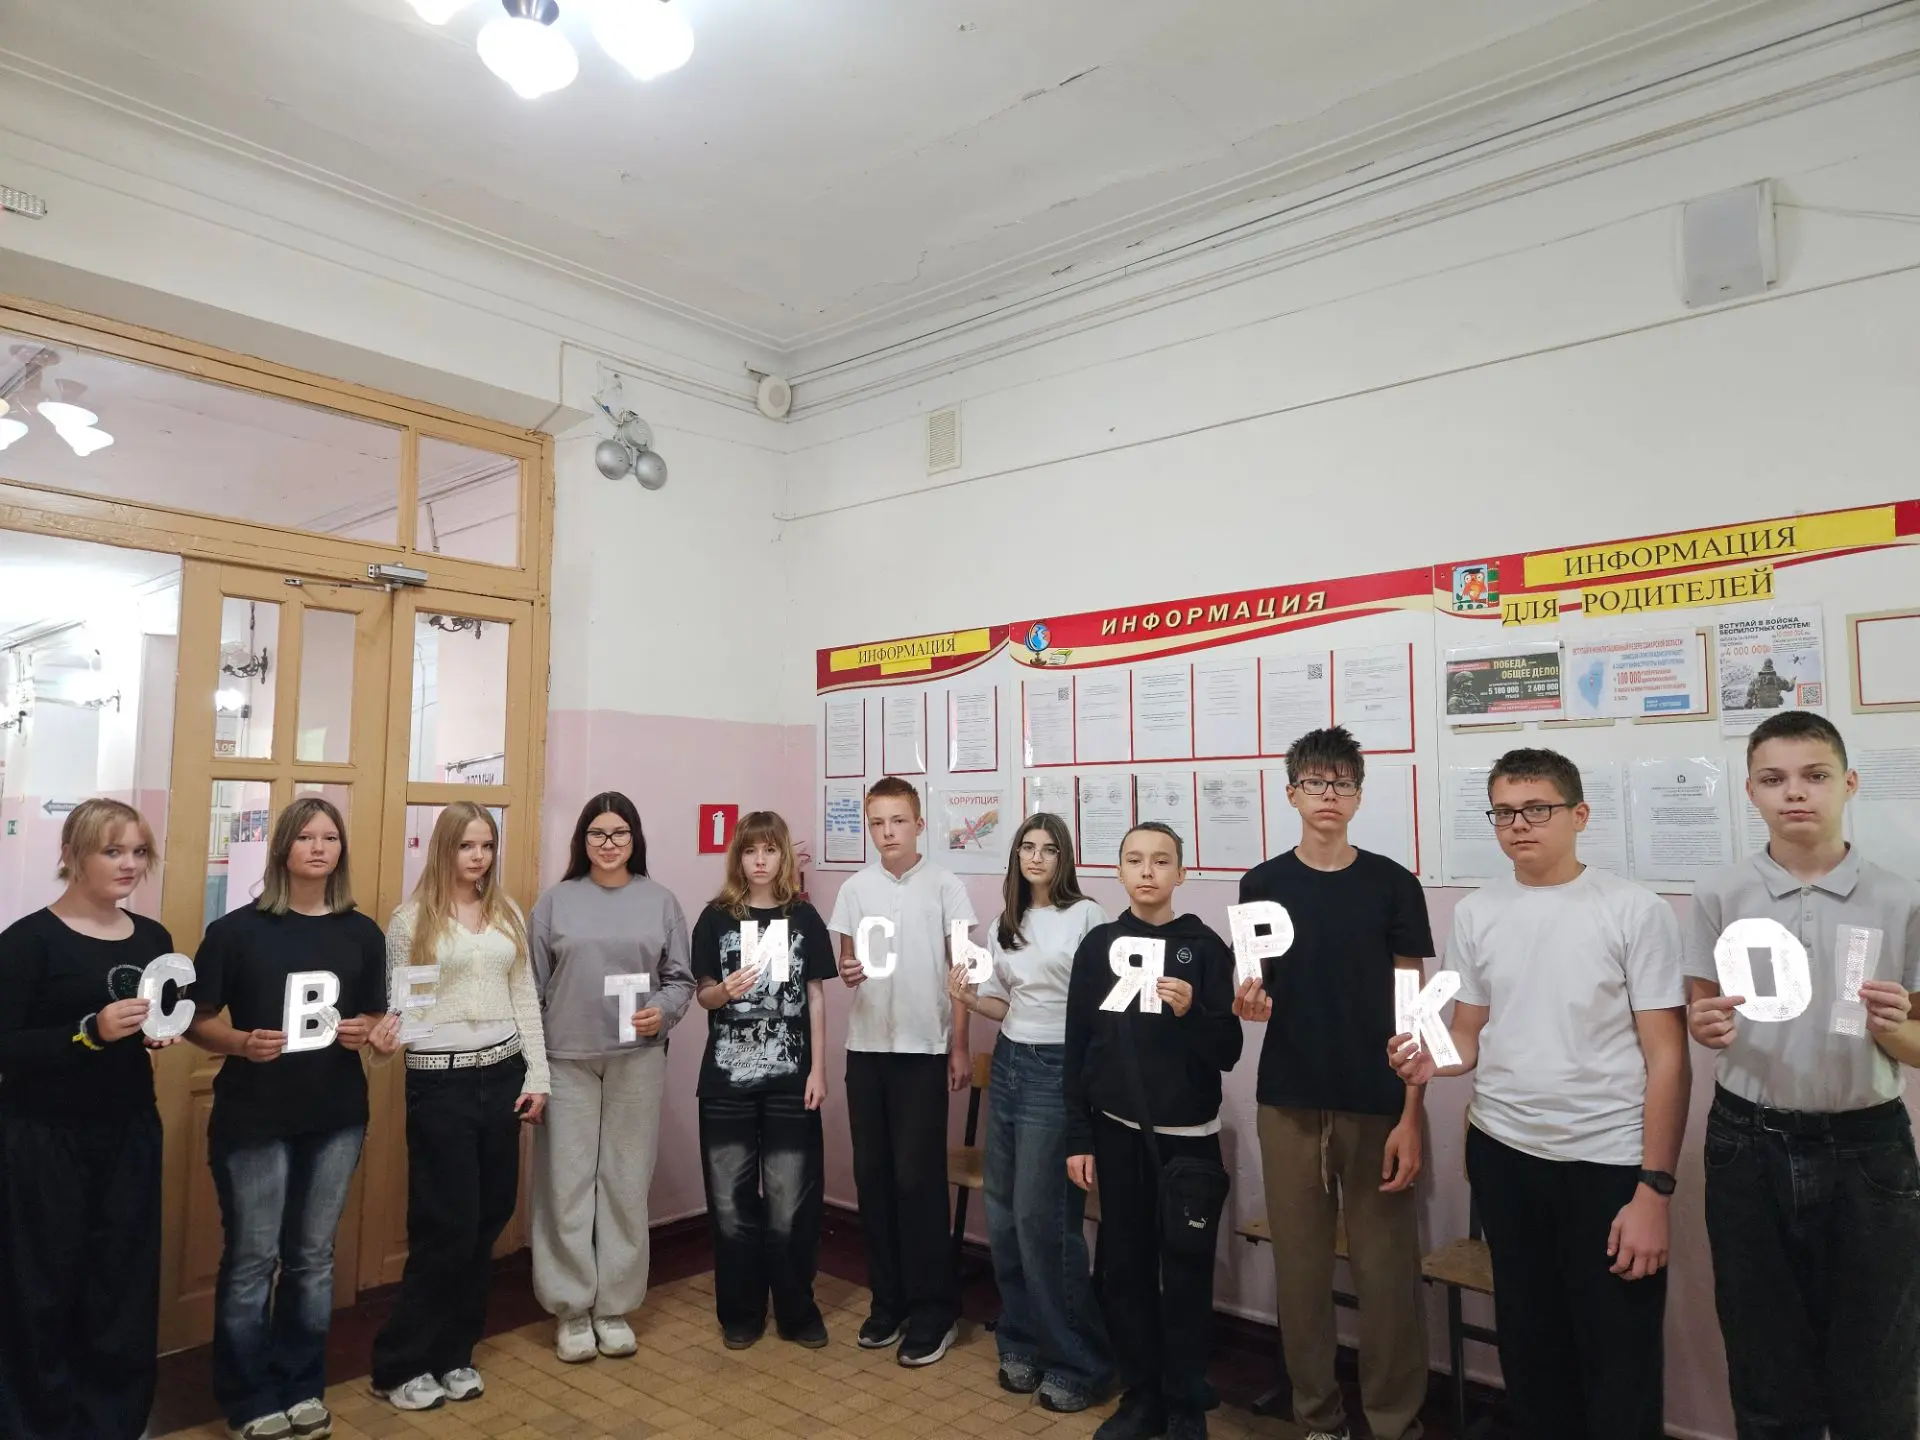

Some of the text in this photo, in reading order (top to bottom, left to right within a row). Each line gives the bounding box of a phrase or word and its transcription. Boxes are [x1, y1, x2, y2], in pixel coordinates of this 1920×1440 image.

[1563, 526, 1797, 577] ИНФОРМАЦИЯ
[1502, 566, 1774, 625] ДЛЯ РОДИТЕЛЕЙ
[1101, 591, 1327, 637] ИНФОРМАЦИЯ
[1719, 620, 1757, 630] ВСТУПАЙ
[1765, 616, 1799, 625] ВОЙСКА
[1719, 625, 1776, 636] БЕСПИЛОТНЫХ
[858, 638, 956, 664] ИНФОРМАЦИЯ
[1493, 658, 1527, 669] ПОБЕДА
[1501, 666, 1559, 680] ОБЩЕЕ ДЕЛО!
[949, 795, 999, 805] КОРРУПЦИЯ
